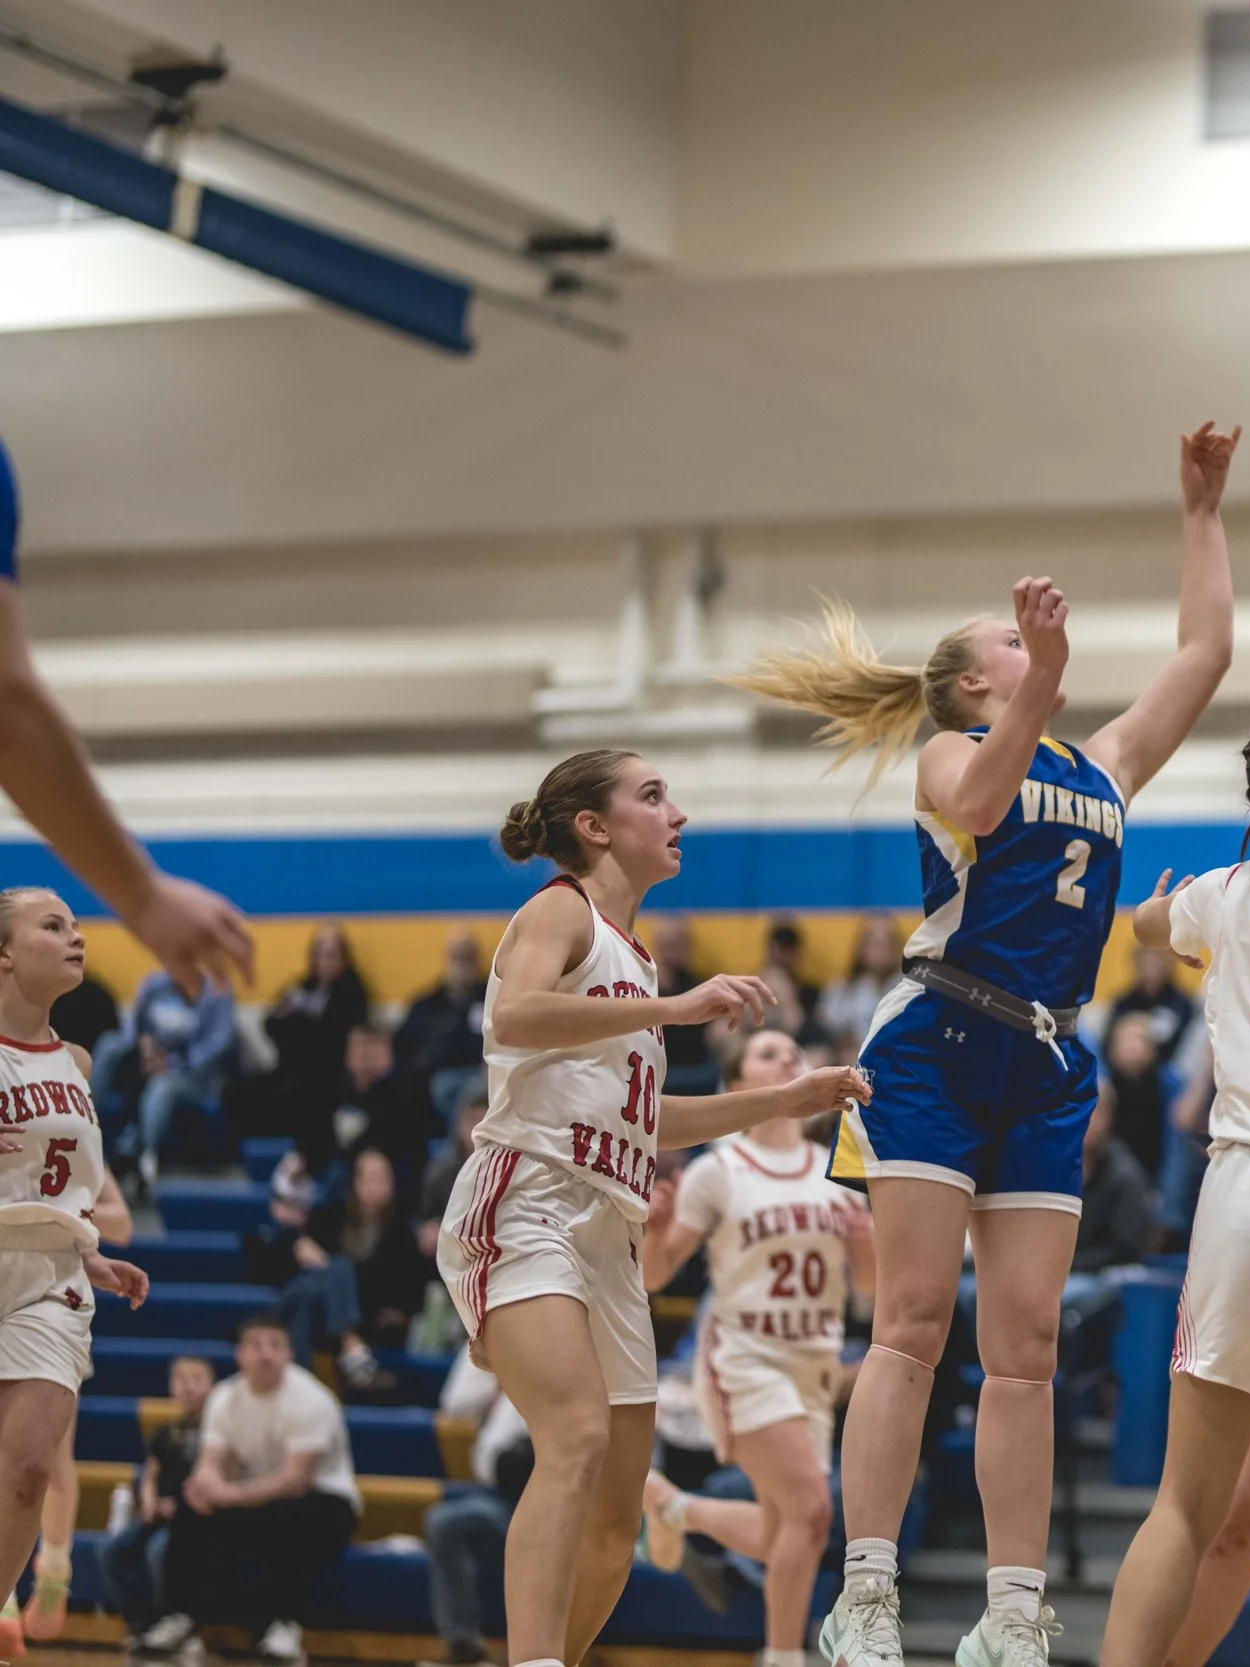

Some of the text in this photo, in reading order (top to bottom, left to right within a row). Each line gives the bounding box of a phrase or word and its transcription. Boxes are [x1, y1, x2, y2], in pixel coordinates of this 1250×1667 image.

[1020, 779, 1123, 848] VIKINGS
[1055, 839, 1091, 909] 2
[0, 1080, 100, 1126] REDWO
[621, 1051, 656, 1136] 10
[40, 1138, 77, 1197] 5
[769, 1250, 828, 1299] 20
